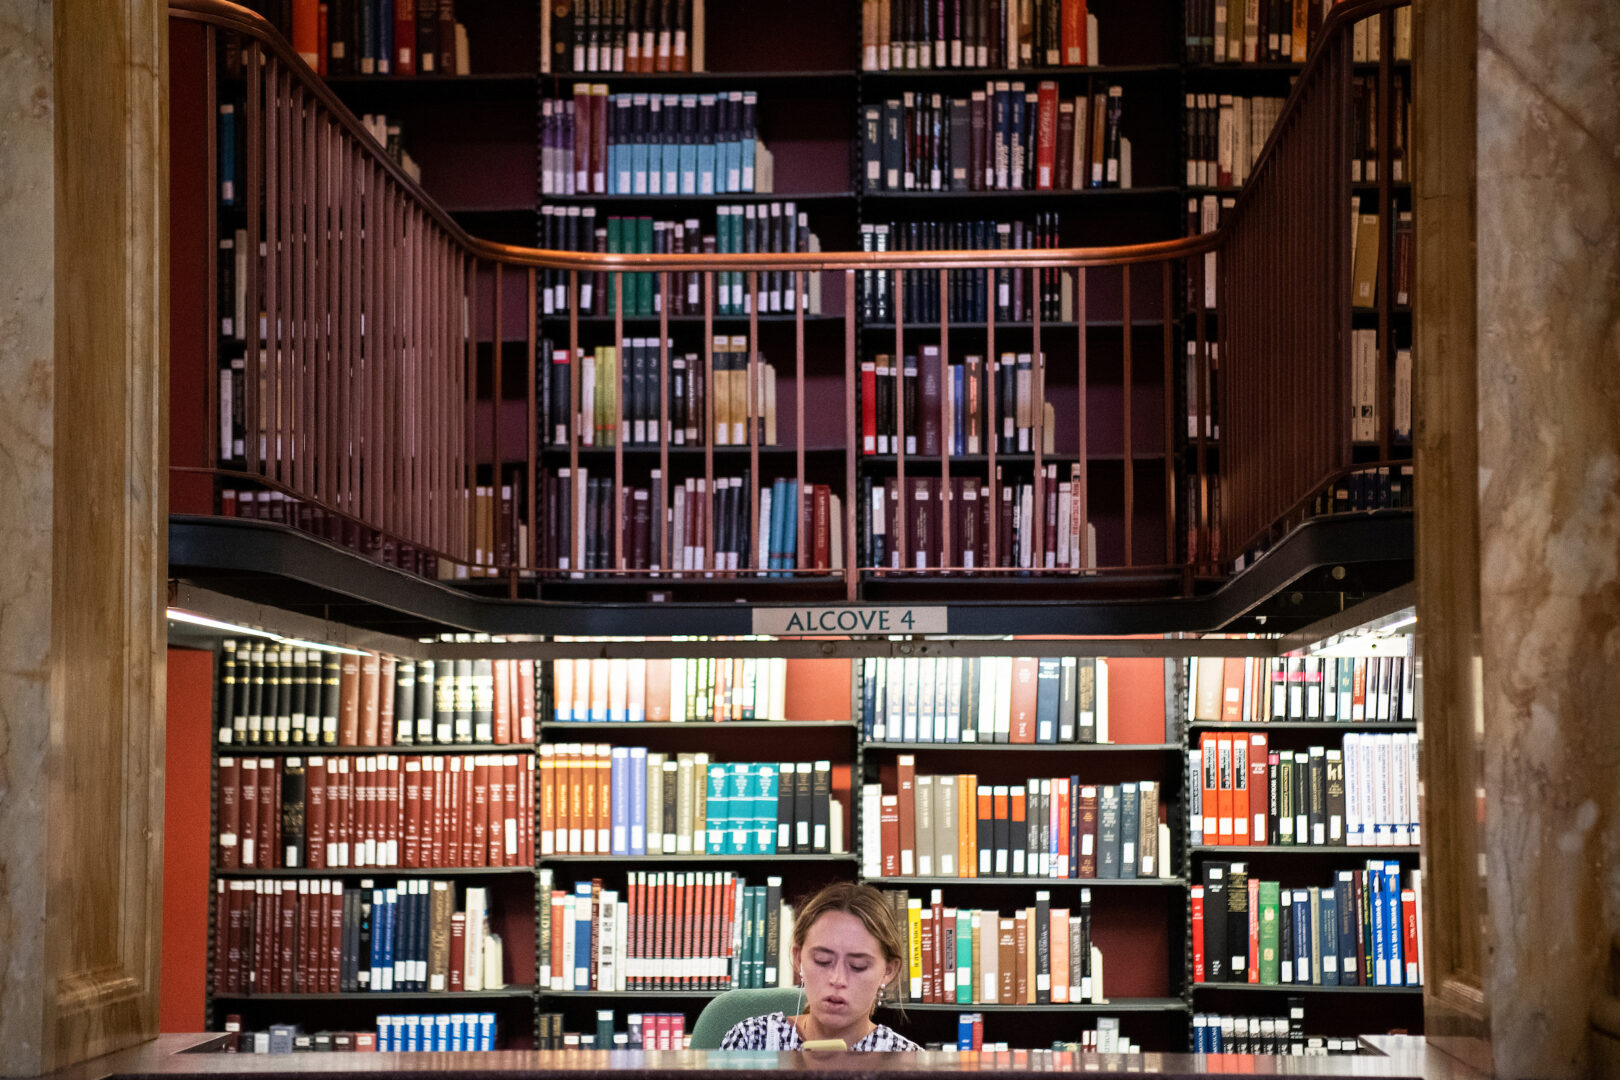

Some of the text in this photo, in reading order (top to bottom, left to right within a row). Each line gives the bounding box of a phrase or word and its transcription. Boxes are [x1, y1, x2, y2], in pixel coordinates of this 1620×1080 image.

[637, 358, 643, 367] 2
[650, 358, 656, 367] 3
[786, 610, 915, 631] ALCOVE 4
[541, 893, 551, 928] WORLD
[541, 930, 551, 952] WAR
[1041, 931, 1049, 954] WORLD
